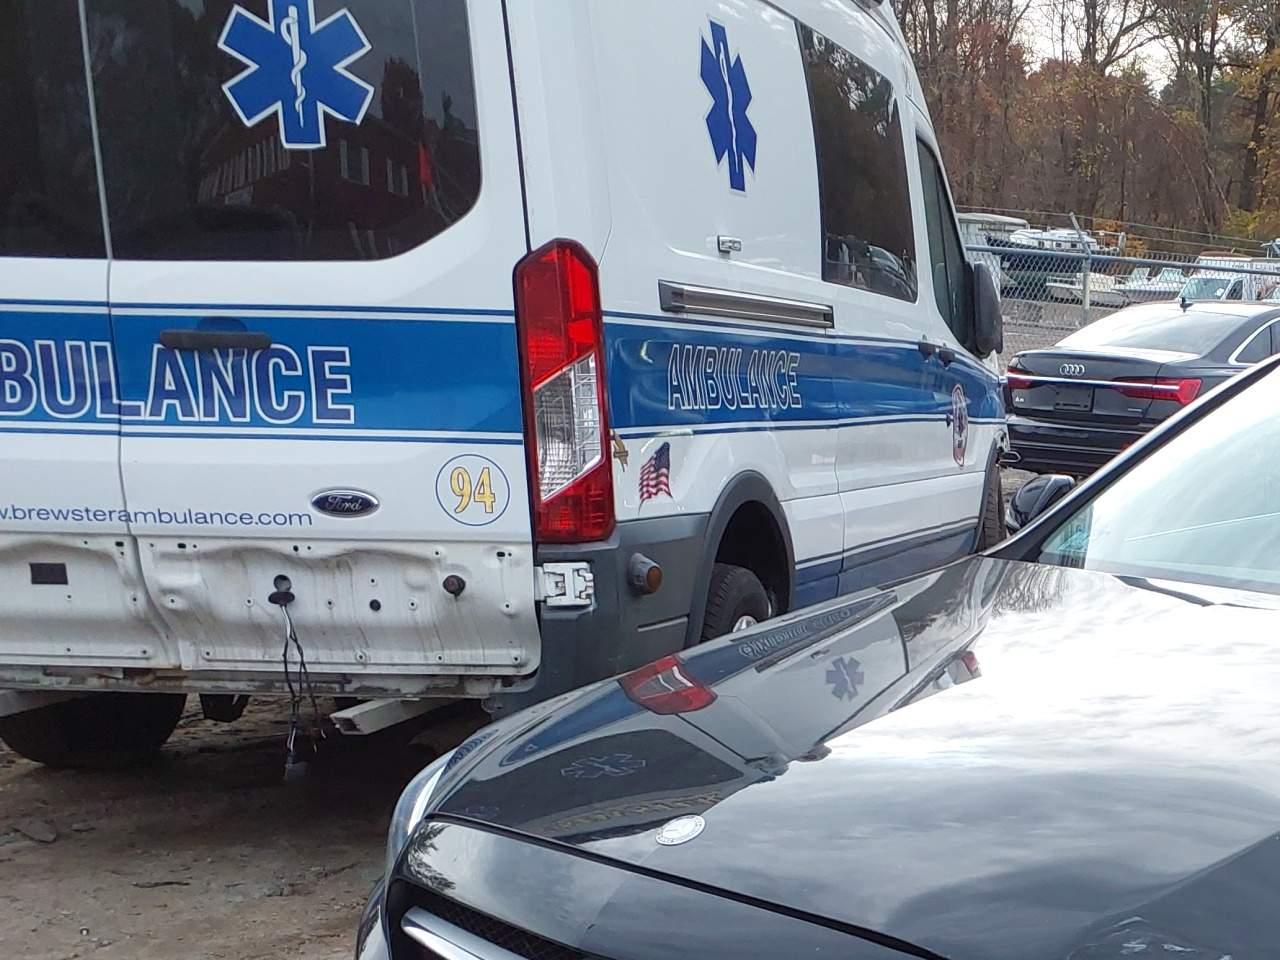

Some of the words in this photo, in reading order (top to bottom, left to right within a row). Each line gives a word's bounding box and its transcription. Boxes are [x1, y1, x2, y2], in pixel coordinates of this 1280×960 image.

[668, 344, 802, 410] AMBULANCE
[324, 495, 363, 513] Ford
[449, 467, 496, 513] 94
